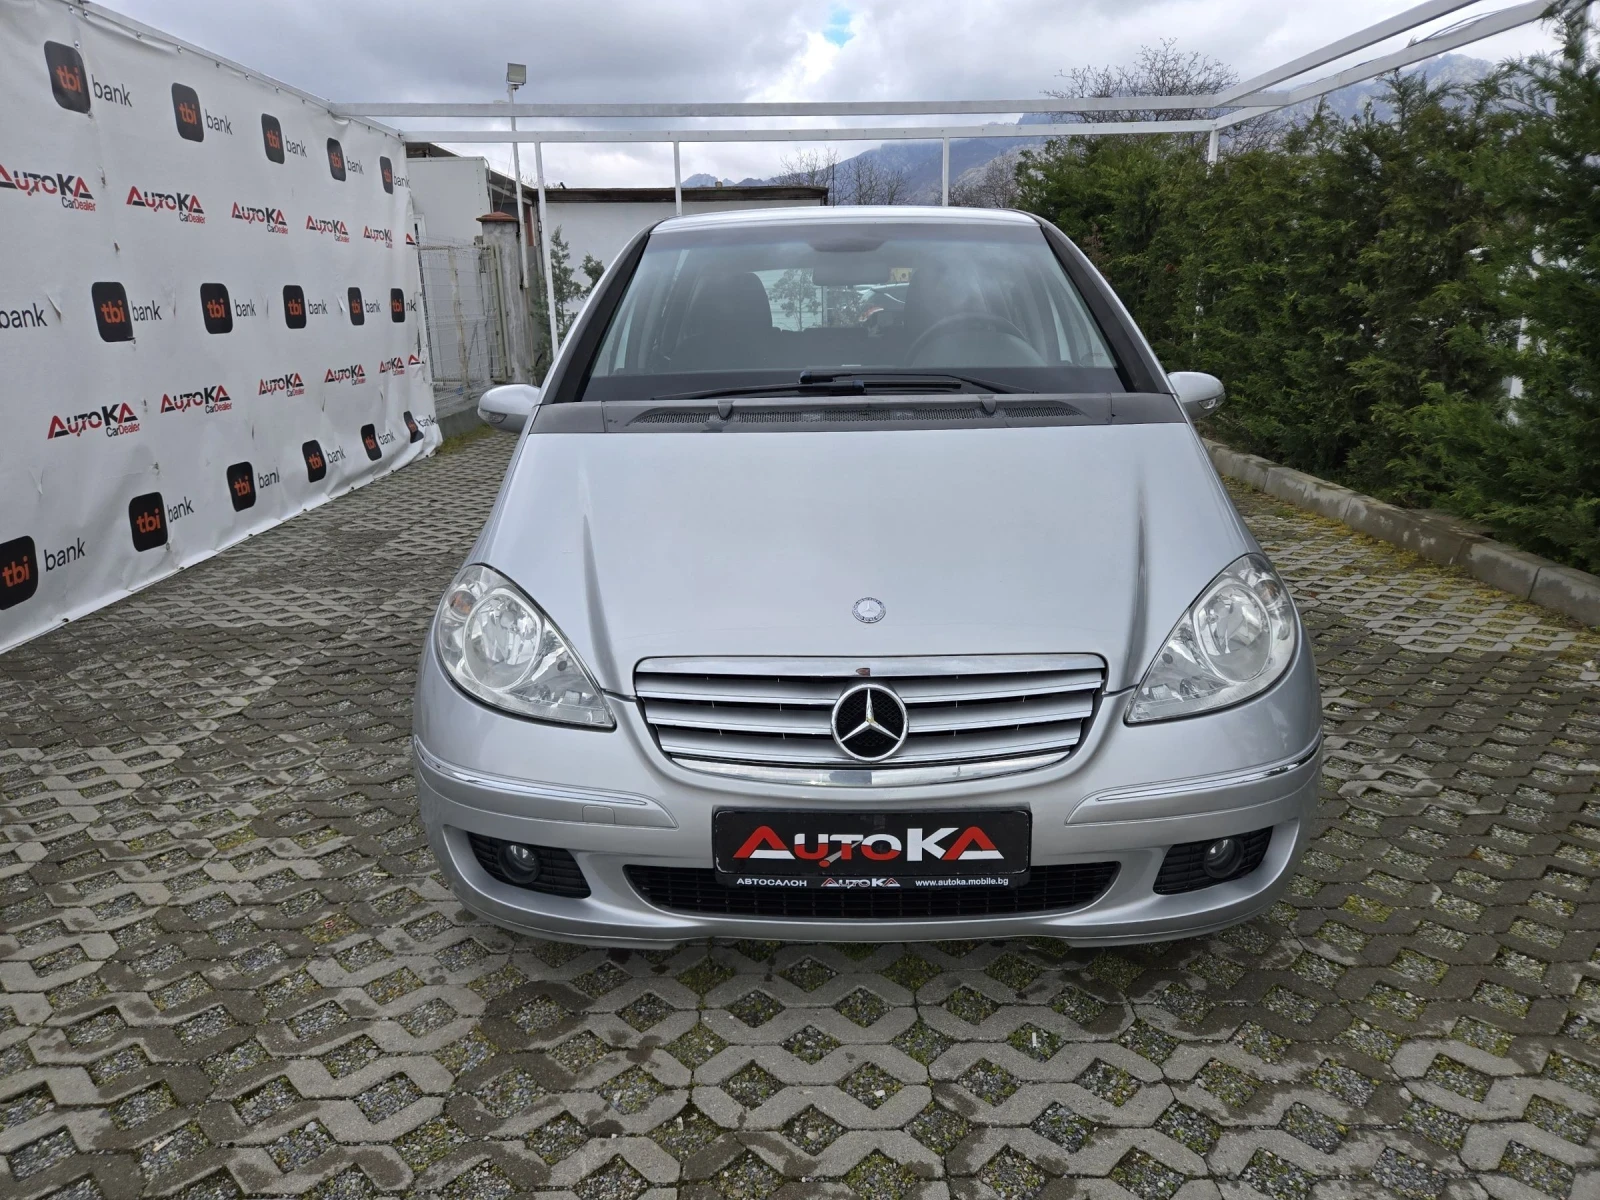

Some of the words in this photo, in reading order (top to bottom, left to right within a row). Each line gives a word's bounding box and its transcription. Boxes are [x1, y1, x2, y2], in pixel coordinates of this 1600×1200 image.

[57, 66, 82, 92] tbi
[91, 74, 133, 107] bank
[178, 102, 197, 125] tbi
[205, 109, 233, 135] bank
[267, 130, 280, 149] tbi
[285, 135, 307, 158] bank
[346, 156, 364, 175] bank
[61, 196, 96, 212] CarDealer
[179, 212, 206, 224] CarDealer
[101, 300, 125, 324] tbi
[131, 300, 162, 322] bank
[206, 299, 226, 319] tbi
[234, 299, 257, 317] bank
[287, 298, 302, 316] tbi
[308, 299, 328, 315] bank
[364, 300, 381, 313] bank
[205, 401, 233, 415] CarDealer
[106, 423, 141, 438] CarDealer
[378, 429, 396, 445] bank
[309, 452, 323, 470] tbi
[325, 446, 346, 463] bank
[234, 476, 251, 497] tbi
[136, 508, 161, 533] tbi
[167, 496, 194, 523] bank
[2, 555, 30, 587] tbi
[44, 538, 86, 572] bank
[915, 878, 1009, 887] www.autoka.mobile.bg
